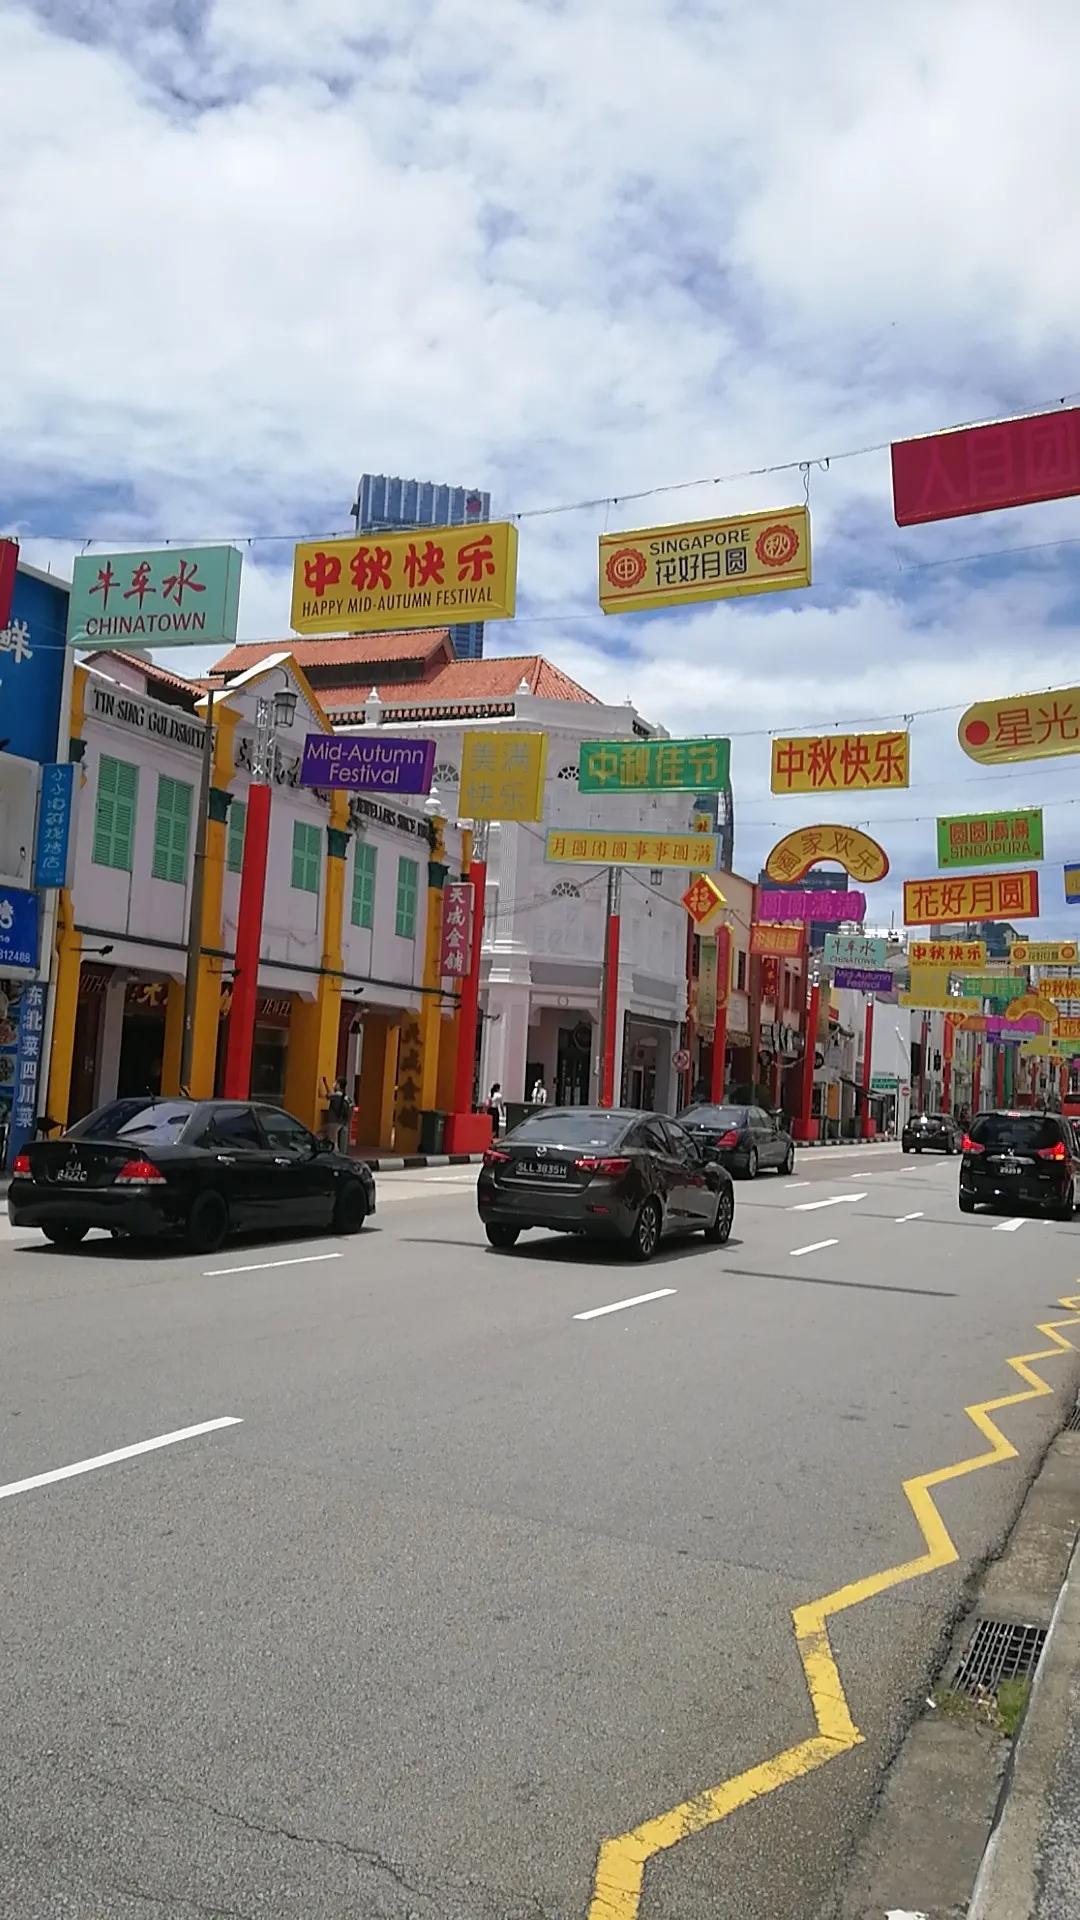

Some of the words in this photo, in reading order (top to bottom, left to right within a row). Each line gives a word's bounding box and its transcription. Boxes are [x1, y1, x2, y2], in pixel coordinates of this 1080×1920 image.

[649, 527, 751, 556] SINGAPORE
[88, 559, 206, 611] 牛车水
[303, 535, 496, 597] 中秋快乐
[655, 547, 747, 586] 花好月圆
[302, 600, 344, 617] HAPPY
[347, 592, 432, 613] MID-AUTUMN
[436, 586, 493, 606] FESTIVAL
[85, 611, 206, 636] CHINATOWN
[93, 689, 115, 715] TIN
[117, 699, 145, 727] SING
[306, 741, 424, 765] Mid-Autumn
[587, 743, 719, 786] 中秋佳节
[776, 735, 905, 788] 中秋快乐
[329, 763, 400, 785] Festival
[950, 841, 1031, 860] SINGAPURA
[911, 878, 1025, 918] 花好月圆
[911, 944, 982, 961] 中秋快乐
[15, 985, 43, 1129] 东北菜四川菜
